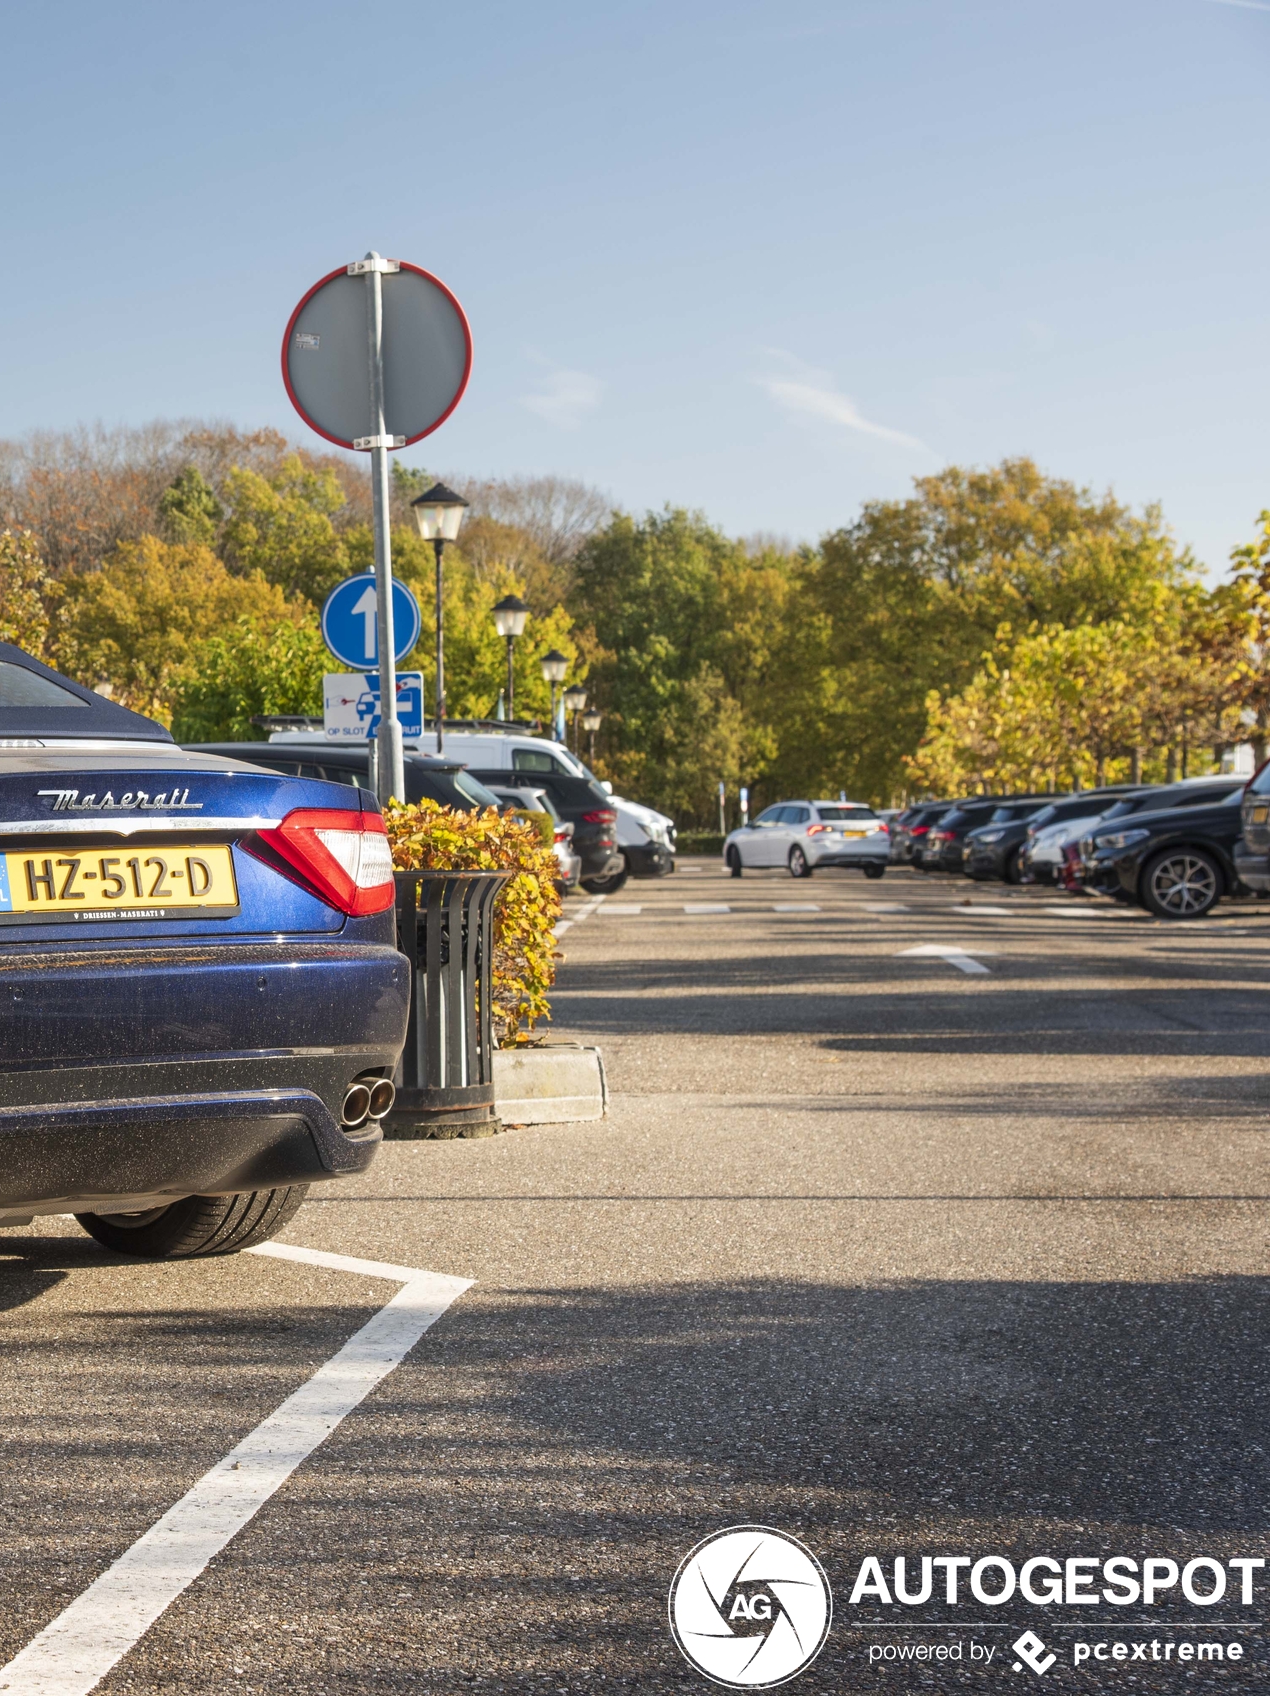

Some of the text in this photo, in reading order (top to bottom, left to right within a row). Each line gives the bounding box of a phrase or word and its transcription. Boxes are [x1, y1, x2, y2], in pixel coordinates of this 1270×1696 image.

[327, 727, 340, 736] OP
[342, 727, 365, 736] SLOT
[37, 788, 203, 811] Maserati
[24, 856, 213, 901] HZ-512-D
[83, 910, 159, 919] DRIESSEN-MASERATI
